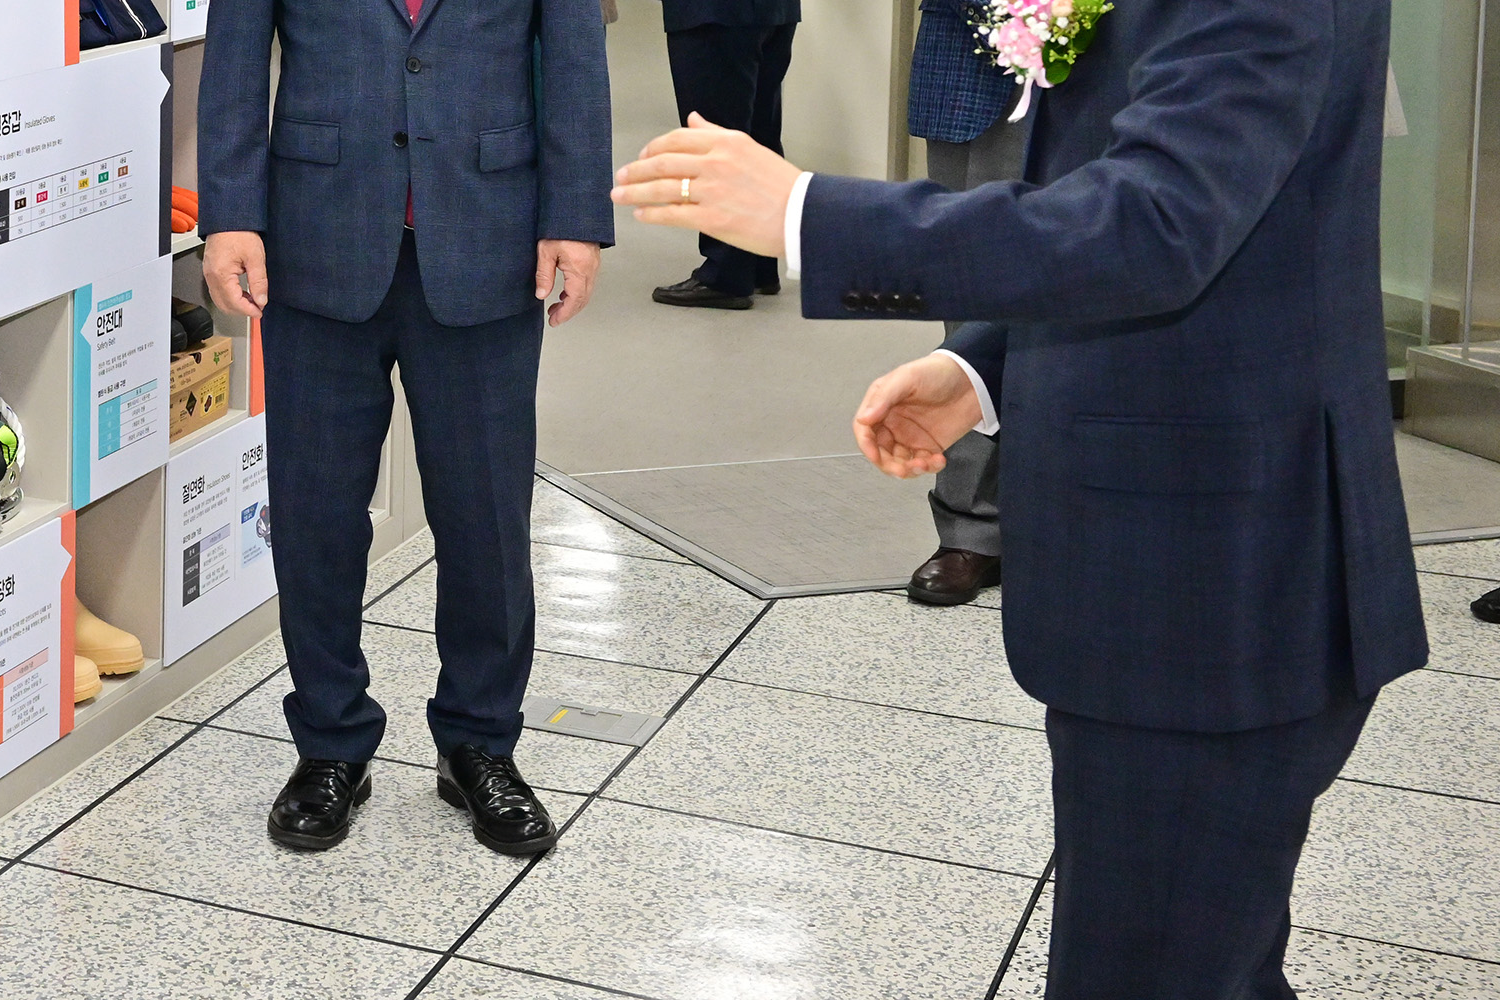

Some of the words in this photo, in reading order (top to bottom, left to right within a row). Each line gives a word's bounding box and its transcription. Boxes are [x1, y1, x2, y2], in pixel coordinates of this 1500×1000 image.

[97, 308, 123, 337] 안전대
[242, 443, 264, 471] 안전화
[182, 475, 206, 505] 절연화
